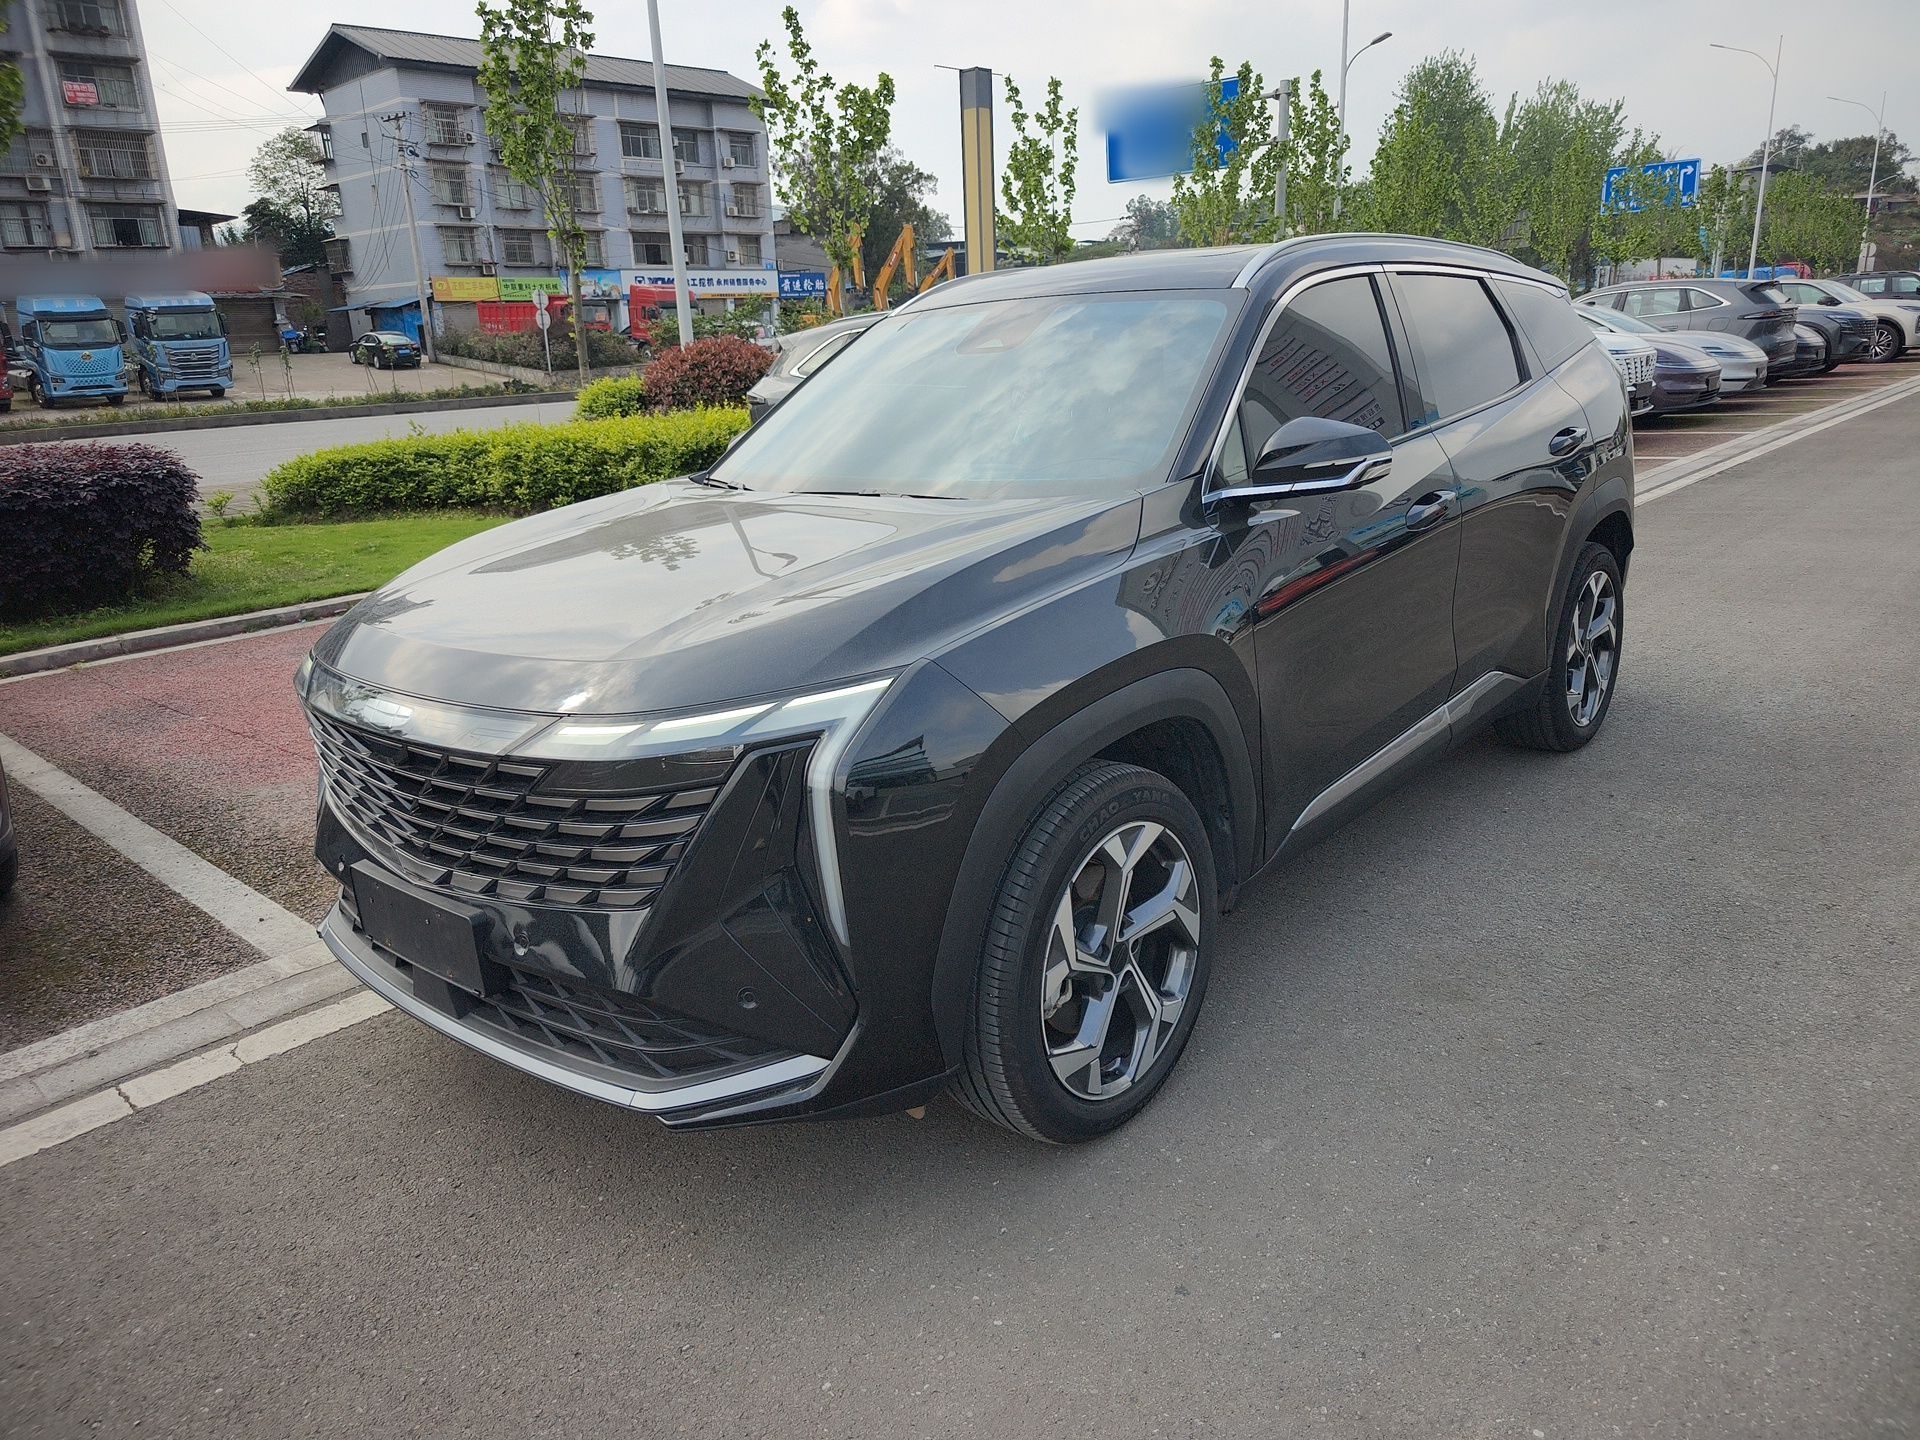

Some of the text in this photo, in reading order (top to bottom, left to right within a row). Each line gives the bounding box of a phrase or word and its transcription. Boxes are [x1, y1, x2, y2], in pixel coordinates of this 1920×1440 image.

[503, 283, 559, 291] 中联重科土方机械
[781, 278, 824, 293] 前进轮胎
